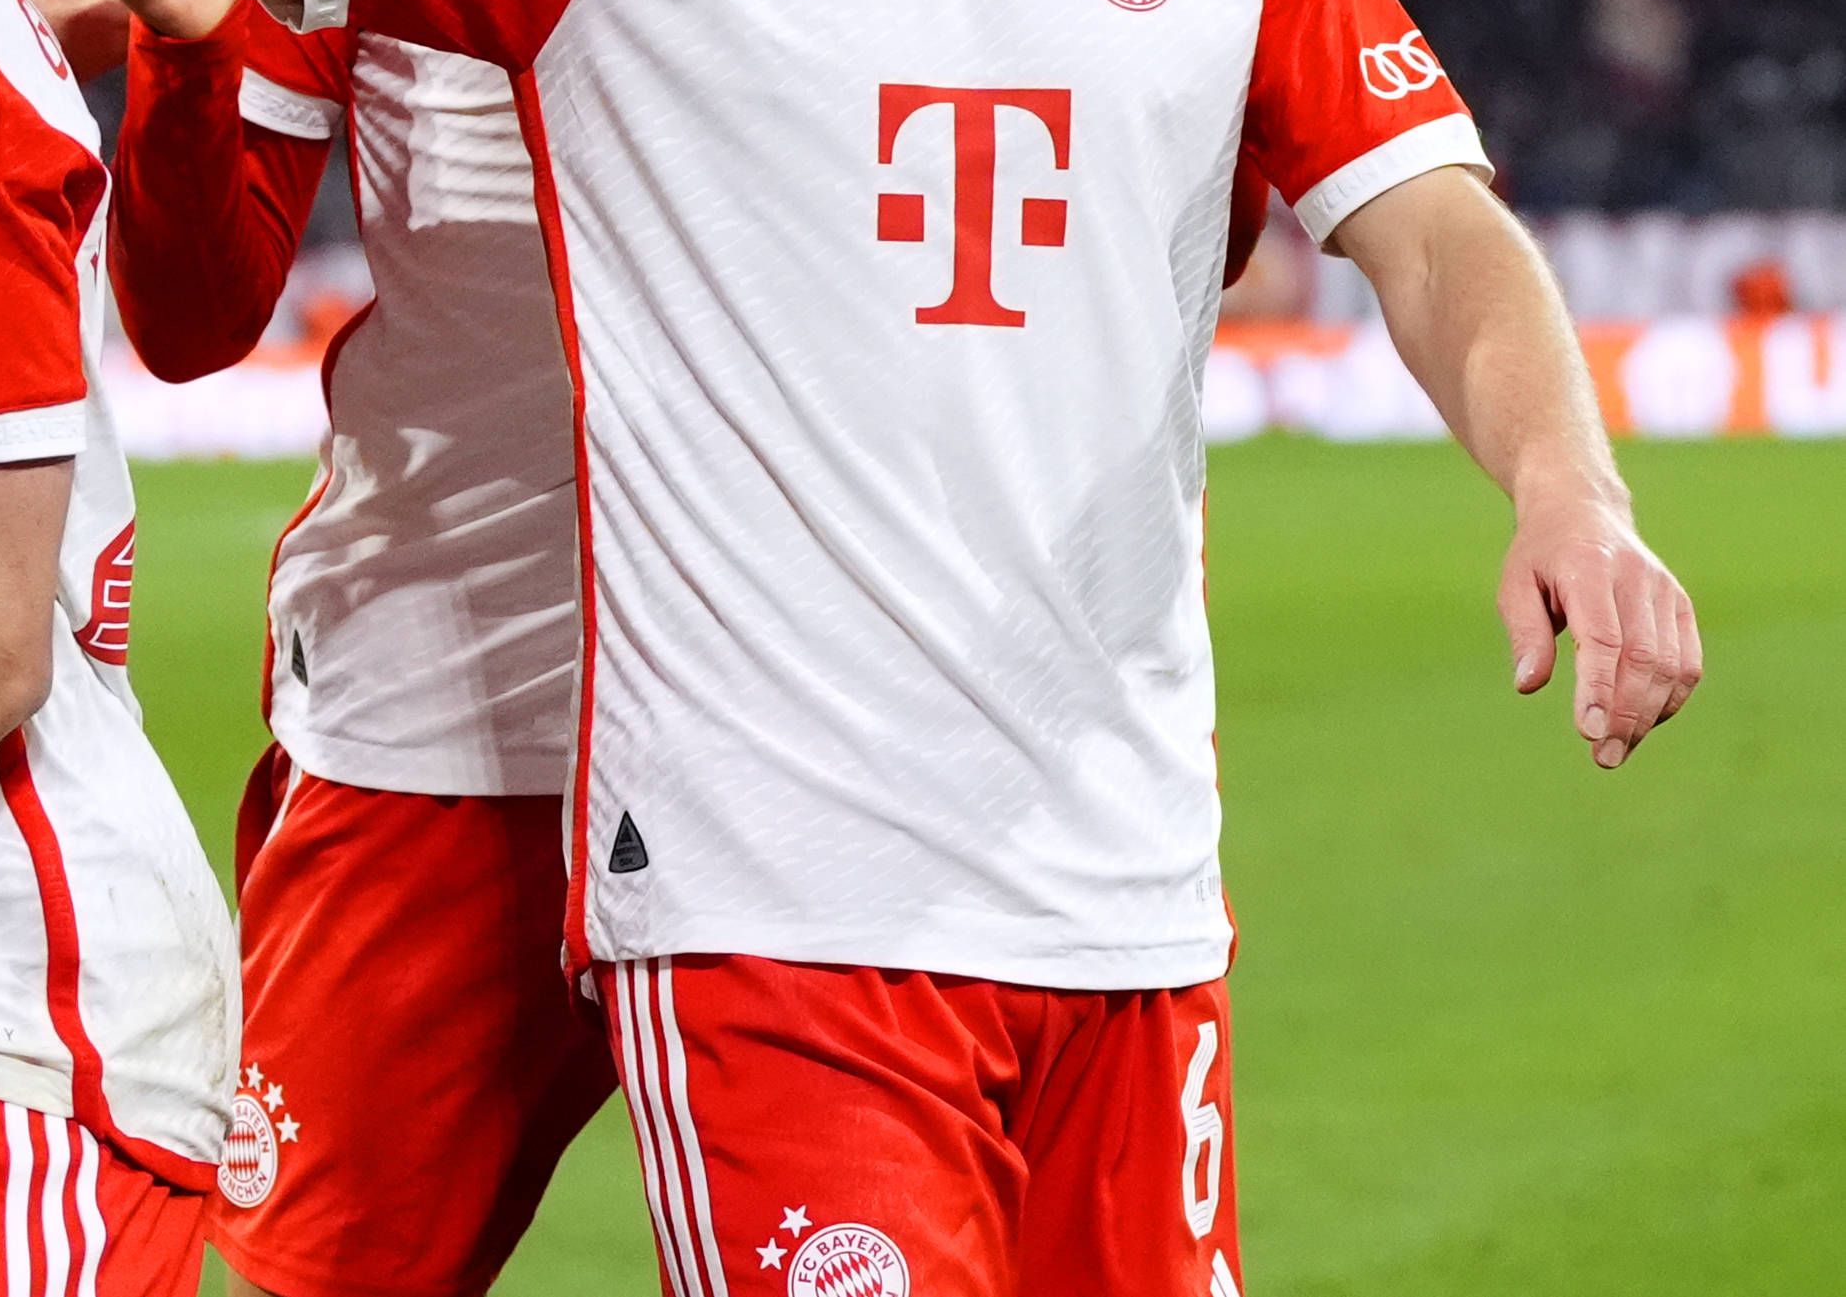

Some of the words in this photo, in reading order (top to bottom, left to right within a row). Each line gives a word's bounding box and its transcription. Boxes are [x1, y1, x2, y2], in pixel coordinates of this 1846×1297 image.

[877, 83, 1071, 328] T
[1180, 1020, 1224, 1240] 6
[798, 1256, 817, 1284] FC
[815, 1233, 895, 1271] BAYERN
